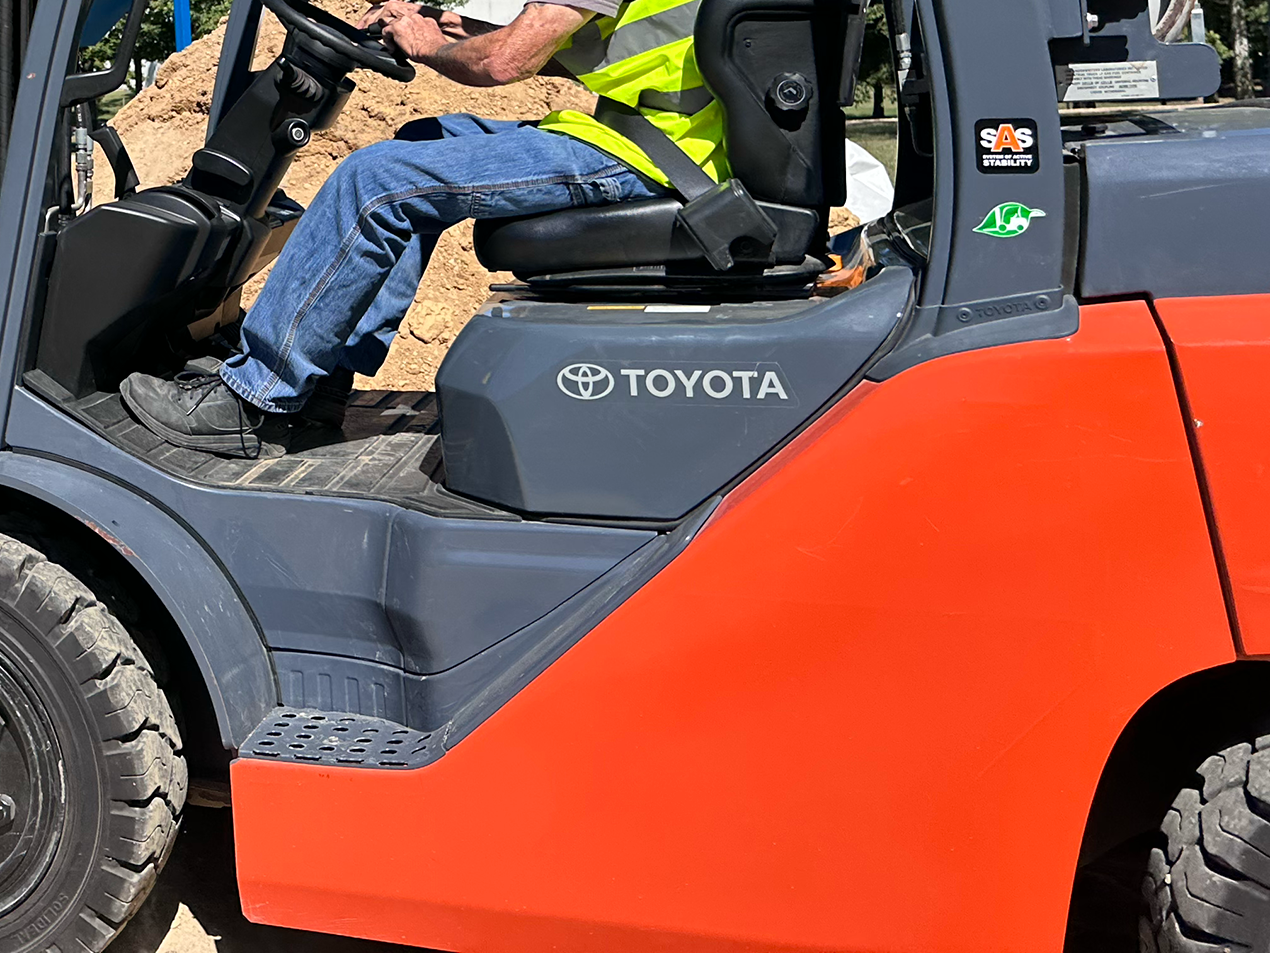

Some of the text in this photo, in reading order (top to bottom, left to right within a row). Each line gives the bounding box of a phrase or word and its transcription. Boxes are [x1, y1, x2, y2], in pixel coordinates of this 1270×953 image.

[979, 123, 1034, 152] SAS
[982, 159, 1033, 167] STABILITY
[975, 301, 1032, 318] TOYOTA
[619, 368, 788, 400] TOYOTA
[10, 892, 69, 944] SOLIDEAL
